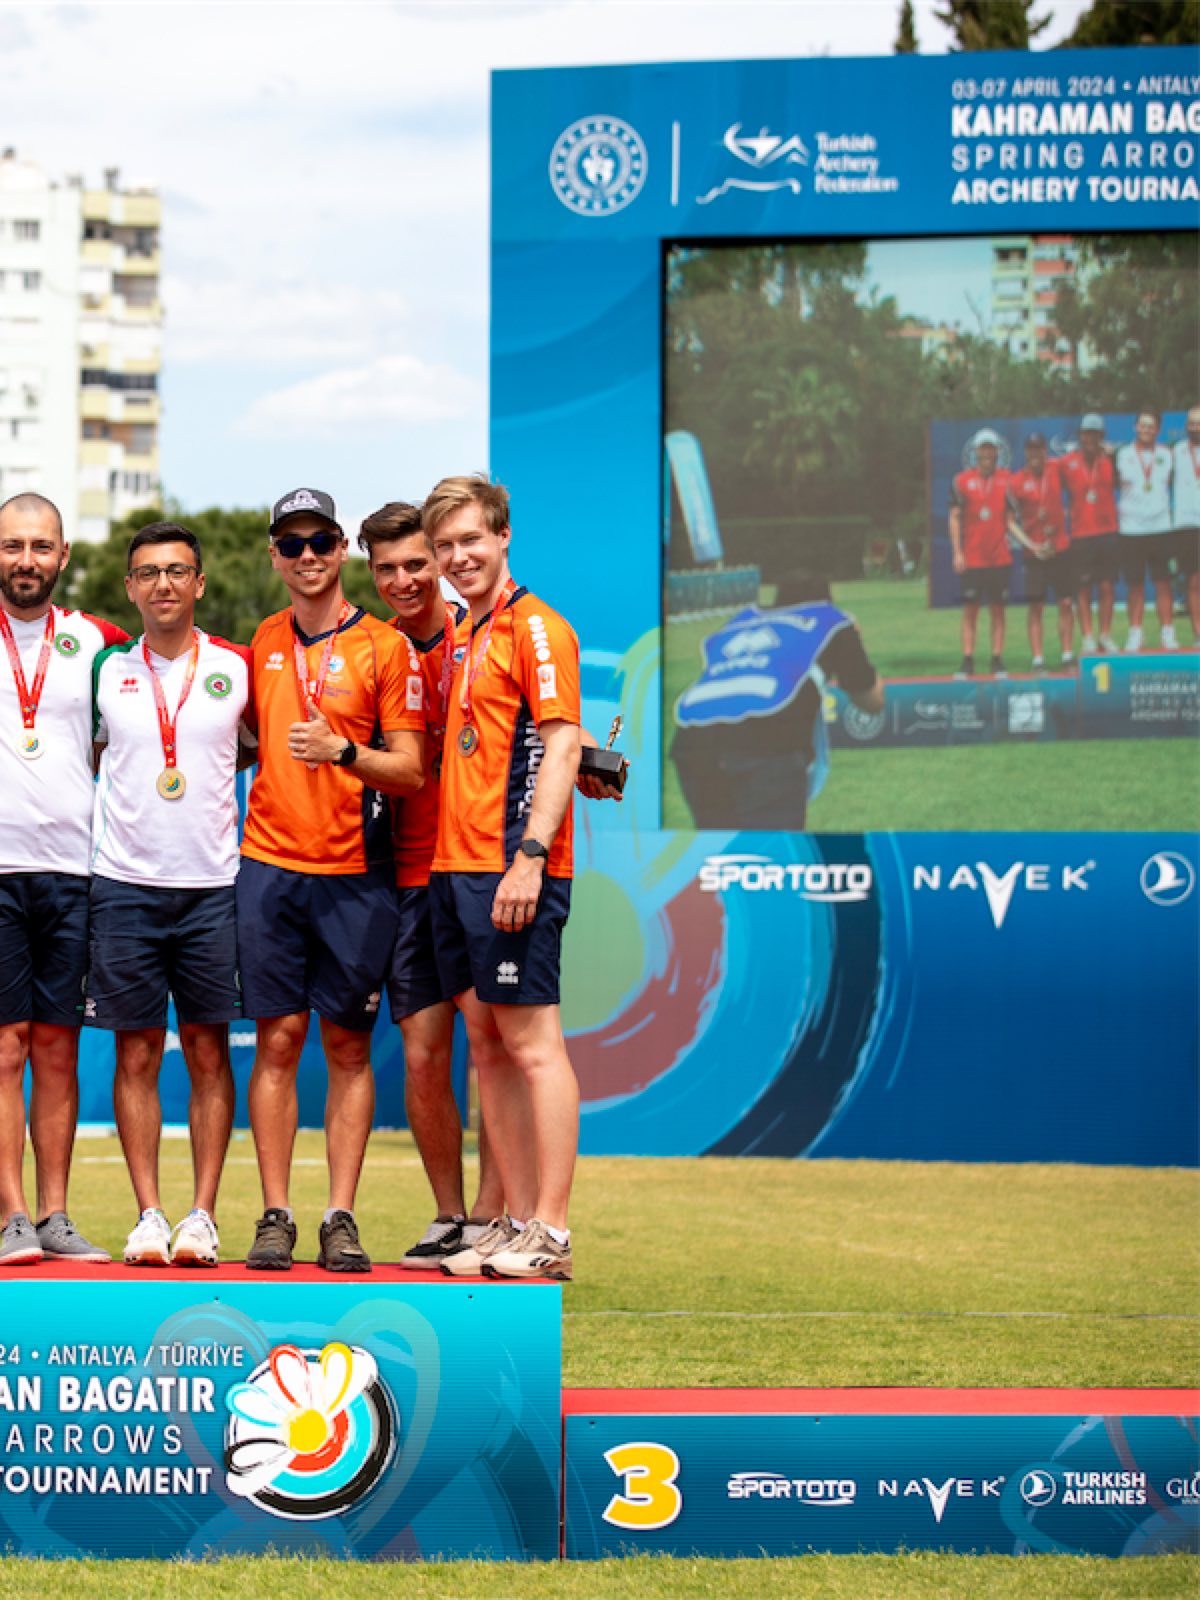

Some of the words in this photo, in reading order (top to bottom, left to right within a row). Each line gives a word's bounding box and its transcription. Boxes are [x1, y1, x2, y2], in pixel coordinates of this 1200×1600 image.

[952, 79, 1006, 99] 03-07
[1012, 77, 1060, 96] APRIL
[1068, 76, 1115, 96] 2024
[952, 102, 1133, 137] KAHRAMAN
[952, 142, 1084, 171] SPRING
[1102, 141, 1194, 168] ARRO
[952, 177, 1079, 204] ARCHERY
[1087, 175, 1200, 202] TOURNA
[699, 858, 872, 898] SPORTOTO
[47, 1345, 137, 1366] ANTALYA
[160, 1341, 244, 1367] TÜRKİYE
[59, 1375, 215, 1413] BAGATIR
[5, 1423, 182, 1455] ARROWS
[602, 1442, 682, 1530] 3
[727, 1475, 856, 1503] SPORTOTO
[1063, 1472, 1146, 1488] TURKISH
[1062, 1489, 1146, 1505] AIRLINES
